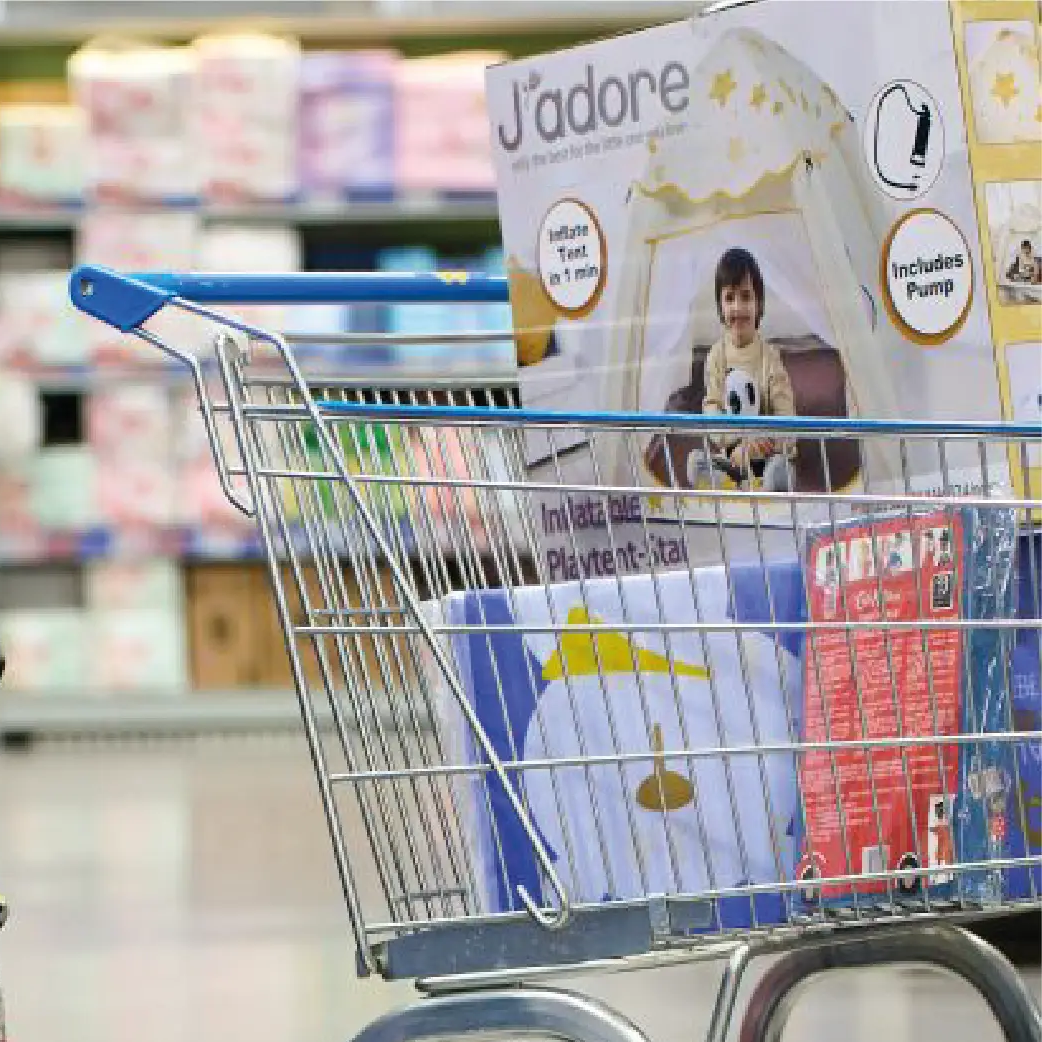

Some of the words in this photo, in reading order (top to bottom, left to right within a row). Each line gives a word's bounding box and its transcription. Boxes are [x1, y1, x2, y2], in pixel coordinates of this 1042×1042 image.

[499, 60, 689, 152] J'adore
[548, 224, 589, 244] Inflate
[557, 244, 589, 262] Tent
[574, 264, 599, 281] min
[891, 253, 963, 279] Includes
[906, 279, 954, 300] Pump
